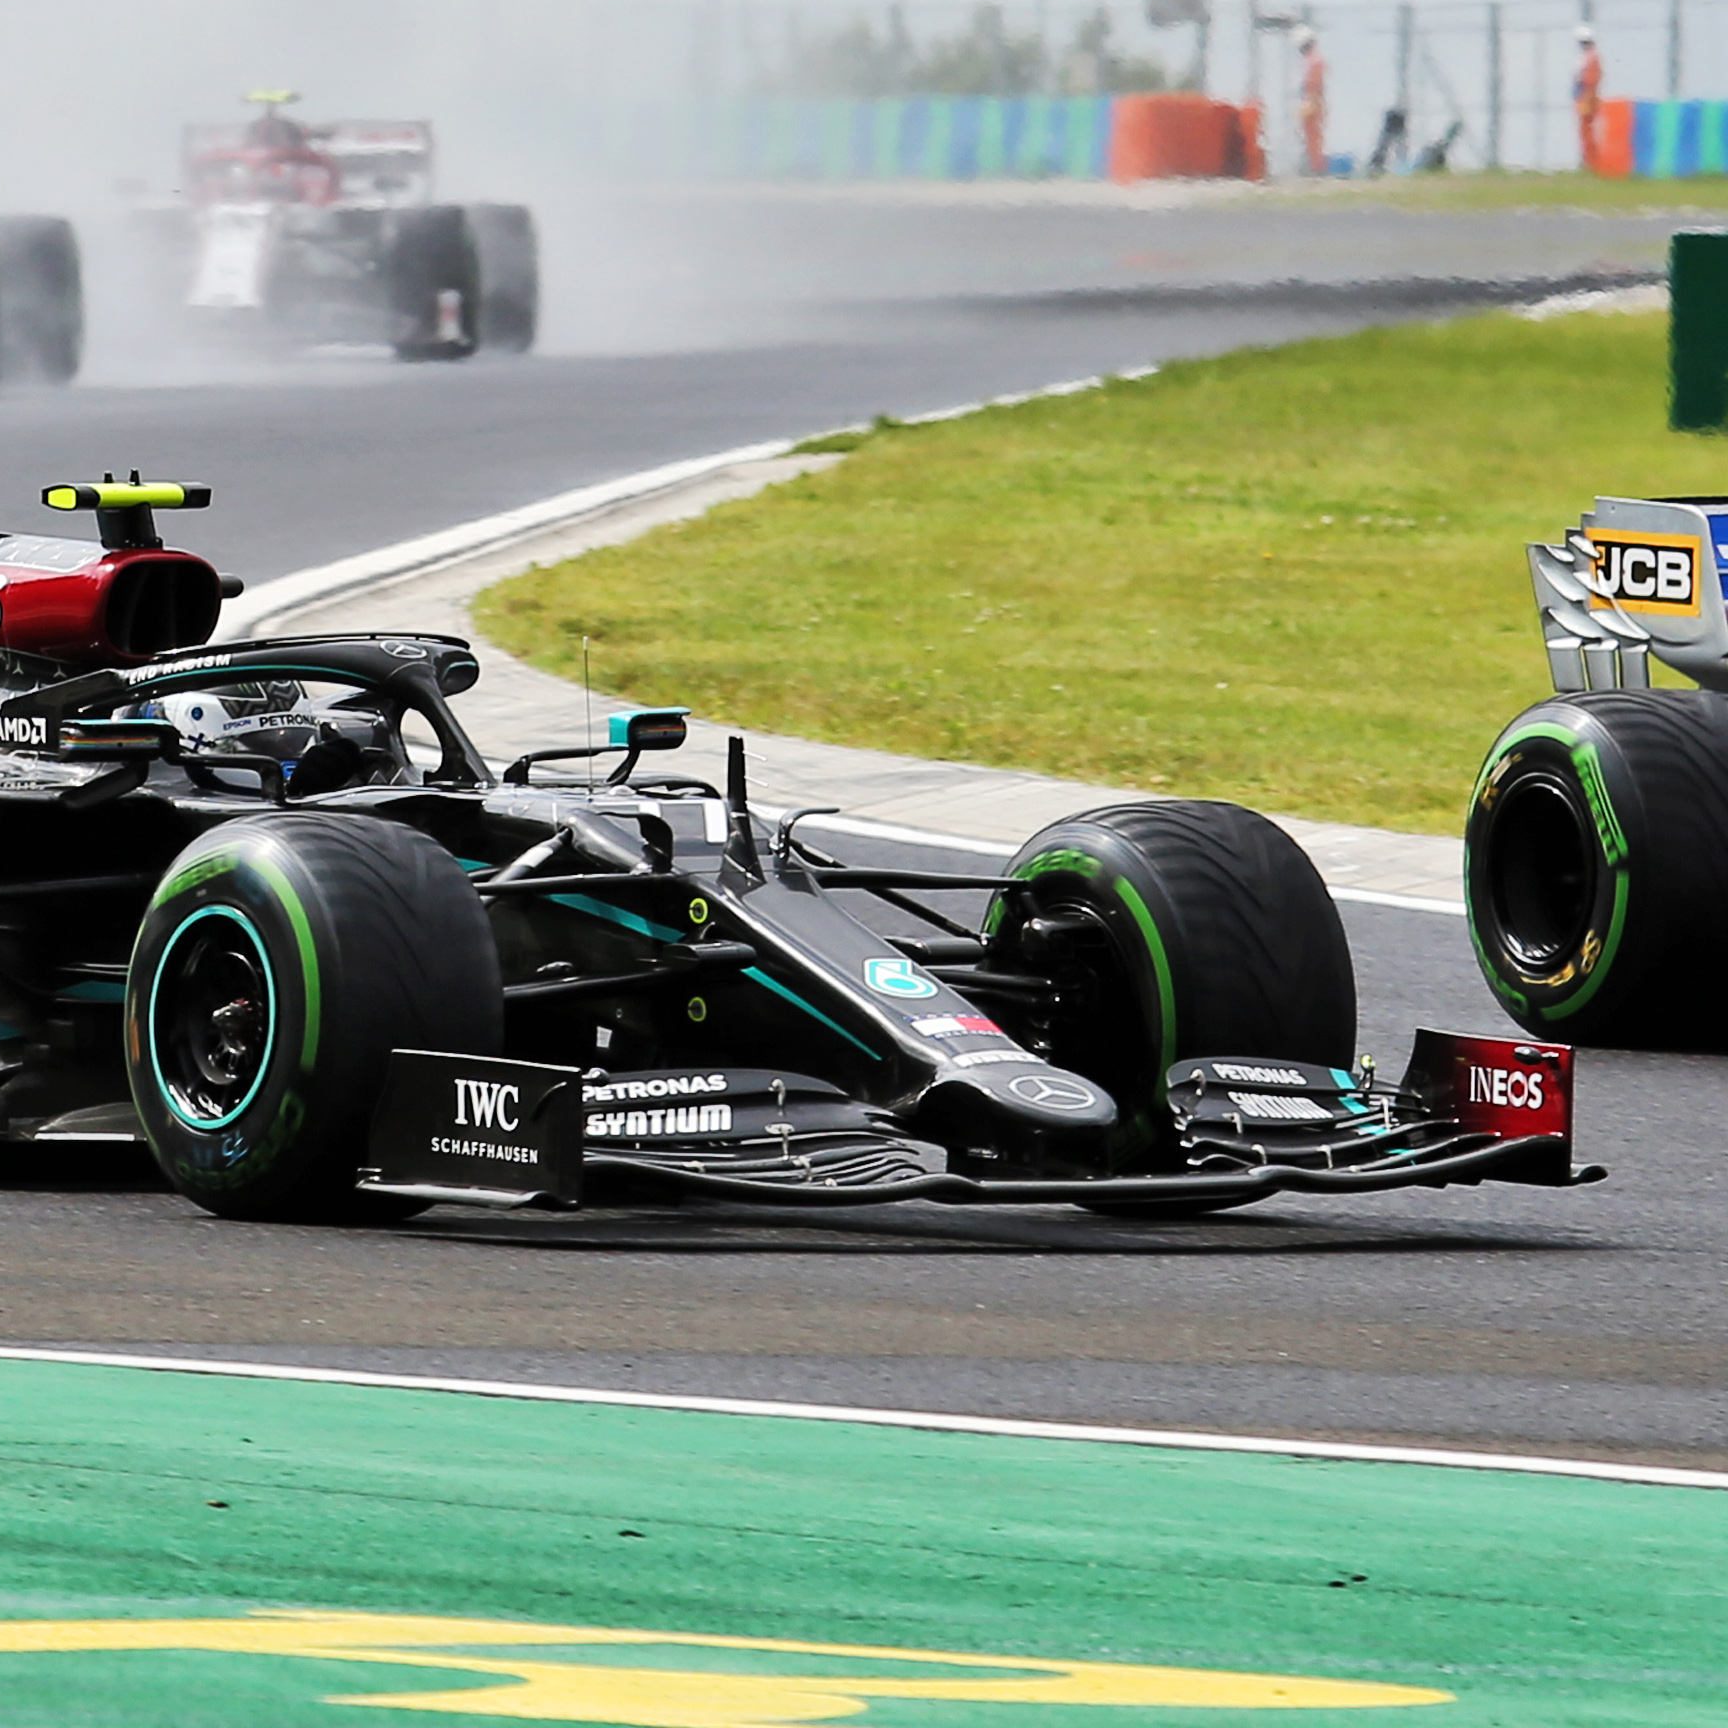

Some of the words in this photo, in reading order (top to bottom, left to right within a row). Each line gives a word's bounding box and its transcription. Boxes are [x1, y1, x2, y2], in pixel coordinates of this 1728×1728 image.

[1596, 545, 1693, 600] JCB
[128, 664, 158, 685] END
[162, 653, 232, 675] RACISM
[223, 718, 252, 731] EPSON
[258, 713, 318, 728] PETRON
[582, 1073, 728, 1103] PETRONAS
[1212, 1063, 1309, 1086] PETRONAS
[1469, 1064, 1544, 1110] INEOS
[454, 1078, 520, 1132] IWC
[584, 1103, 733, 1138] SYNTIUM
[430, 1136, 539, 1165] SCHAFFHAUSEN
